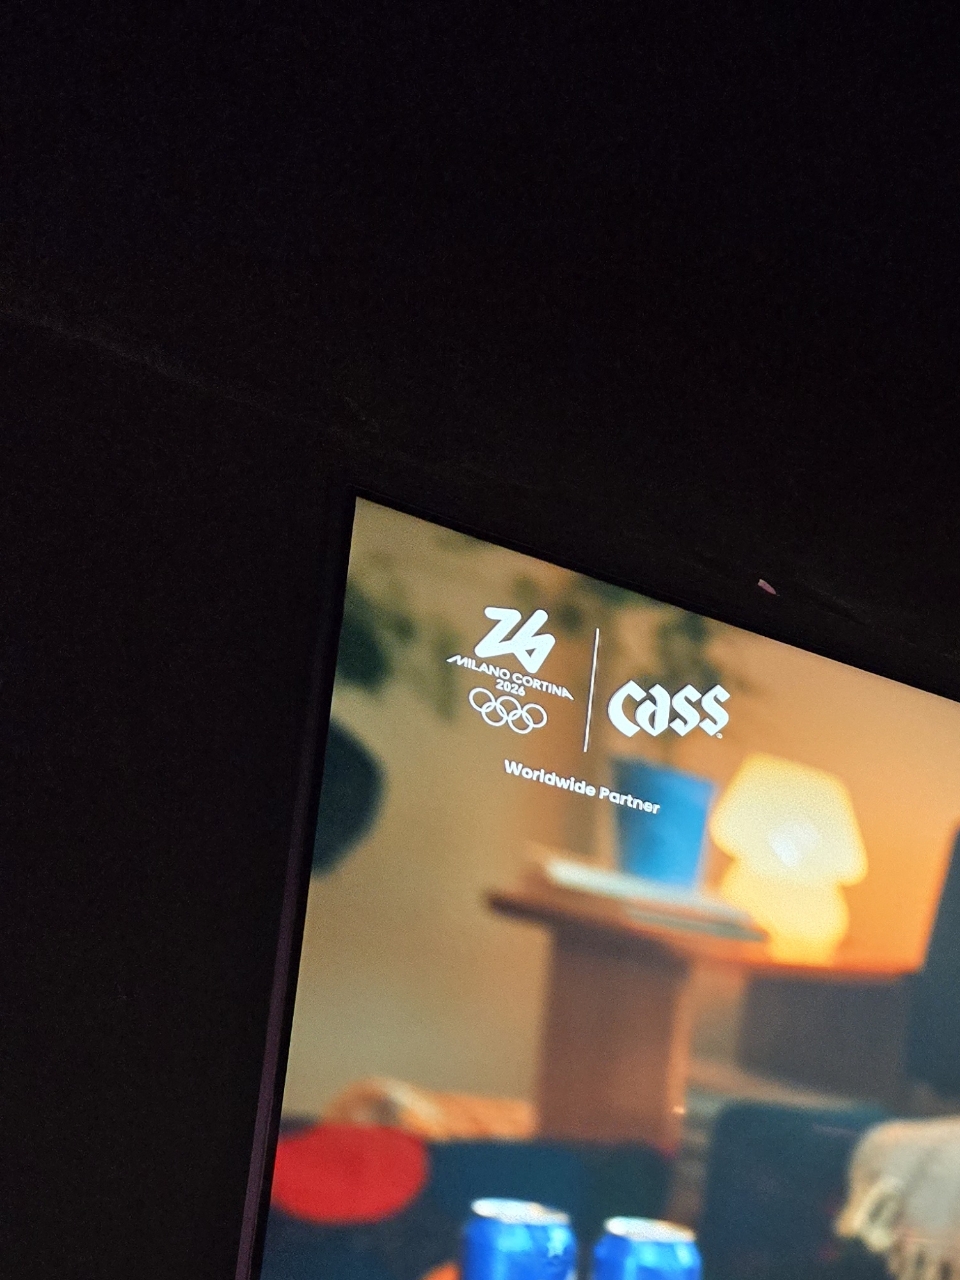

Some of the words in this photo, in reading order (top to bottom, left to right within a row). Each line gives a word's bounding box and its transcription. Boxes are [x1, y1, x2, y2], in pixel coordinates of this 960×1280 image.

[446, 654, 511, 680] MILANO
[512, 672, 575, 701] CORTINA
[495, 678, 526, 697] 2026
[504, 759, 596, 797] Worldwide
[598, 786, 661, 815] Partner
